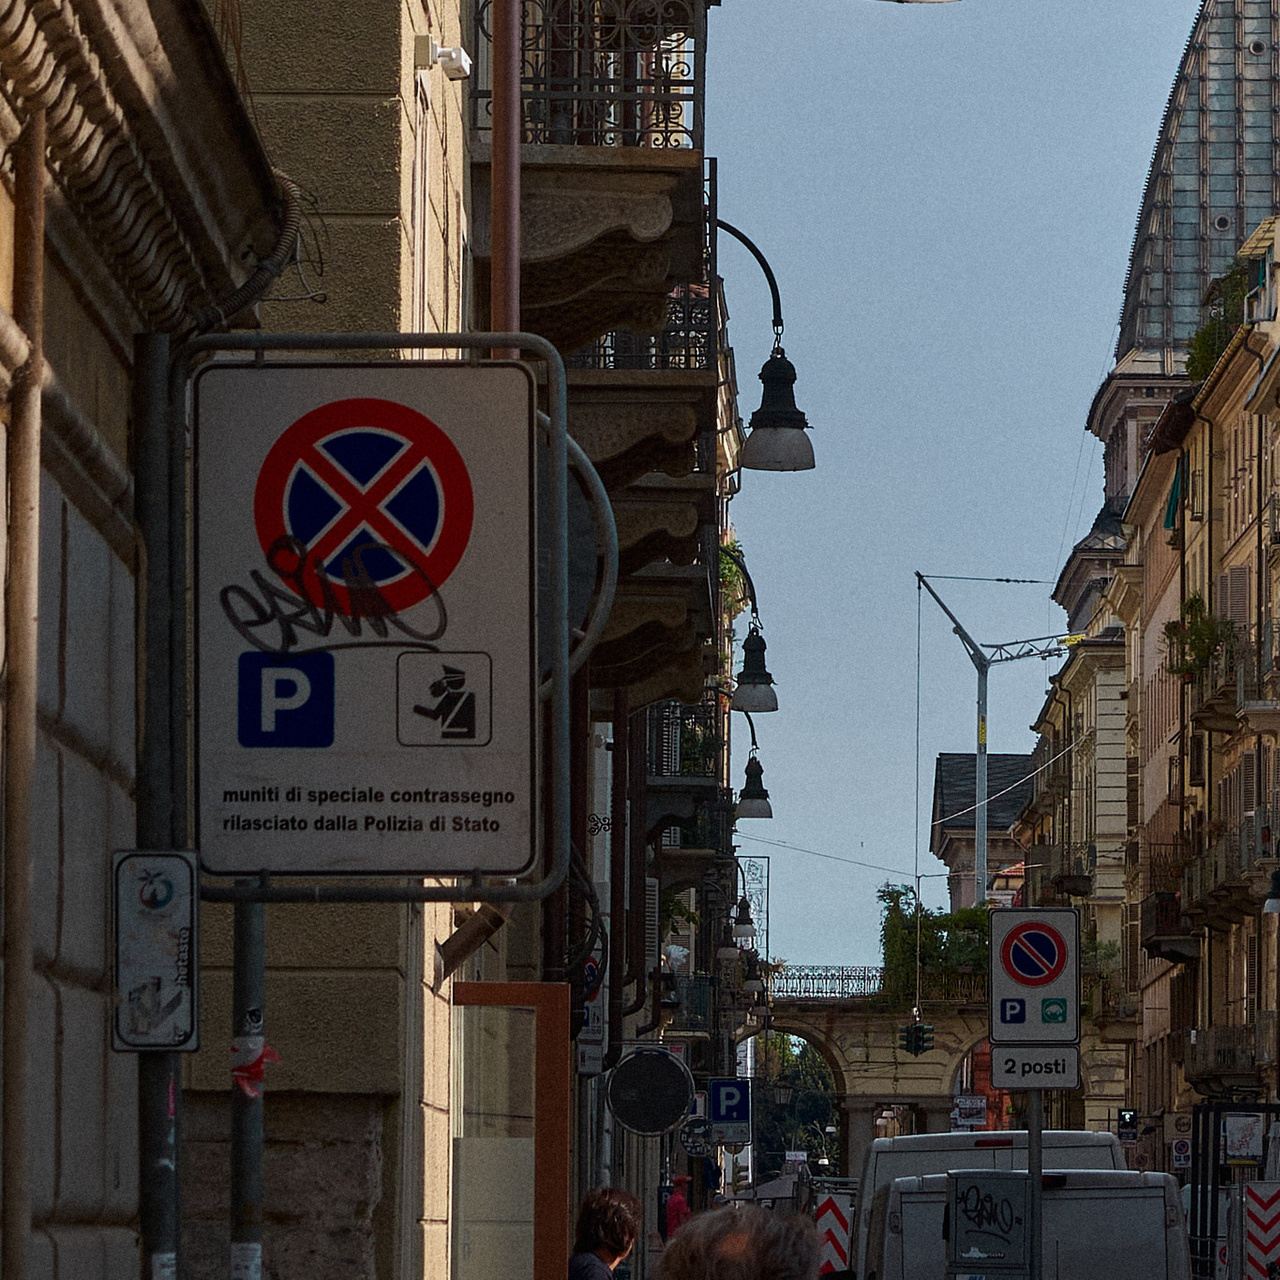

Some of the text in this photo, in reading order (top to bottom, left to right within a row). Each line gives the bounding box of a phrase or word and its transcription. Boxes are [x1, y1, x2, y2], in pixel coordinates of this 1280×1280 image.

[260, 667, 312, 733] P
[222, 787, 515, 807] muniti di speciale contrassegno
[222, 815, 500, 832] rilasciato dalla Polizia di Stato
[1005, 1001, 1020, 1021] P
[1004, 1058, 1066, 1077] 2 posti
[719, 1086, 741, 1116] P
